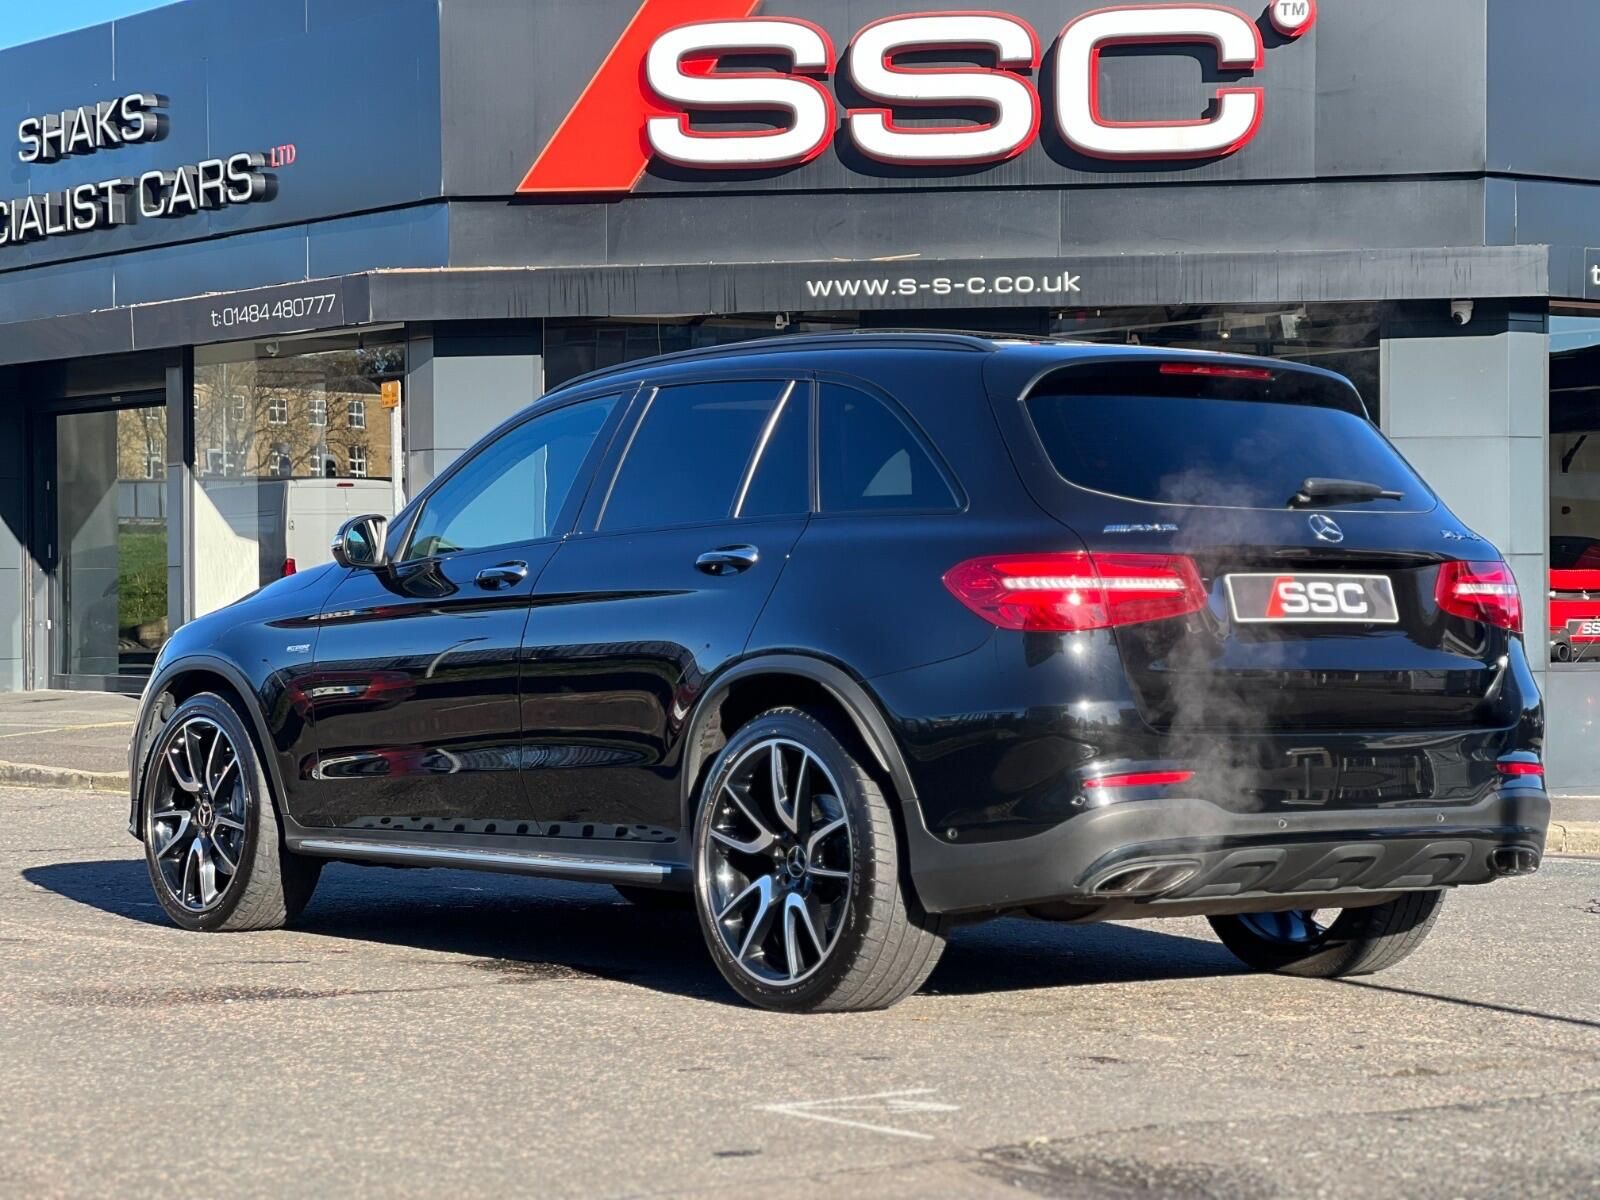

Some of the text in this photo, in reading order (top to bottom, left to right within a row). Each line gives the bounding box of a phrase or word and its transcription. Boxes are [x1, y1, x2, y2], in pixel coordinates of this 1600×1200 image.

[645, 2, 1306, 169] SSC TM
[18, 93, 146, 162] SHAKS
[139, 152, 253, 218] CARS
[270, 143, 297, 168] LTD
[805, 270, 1082, 298] www.s-s-c.co.uk
[1277, 581, 1368, 614] SSC
